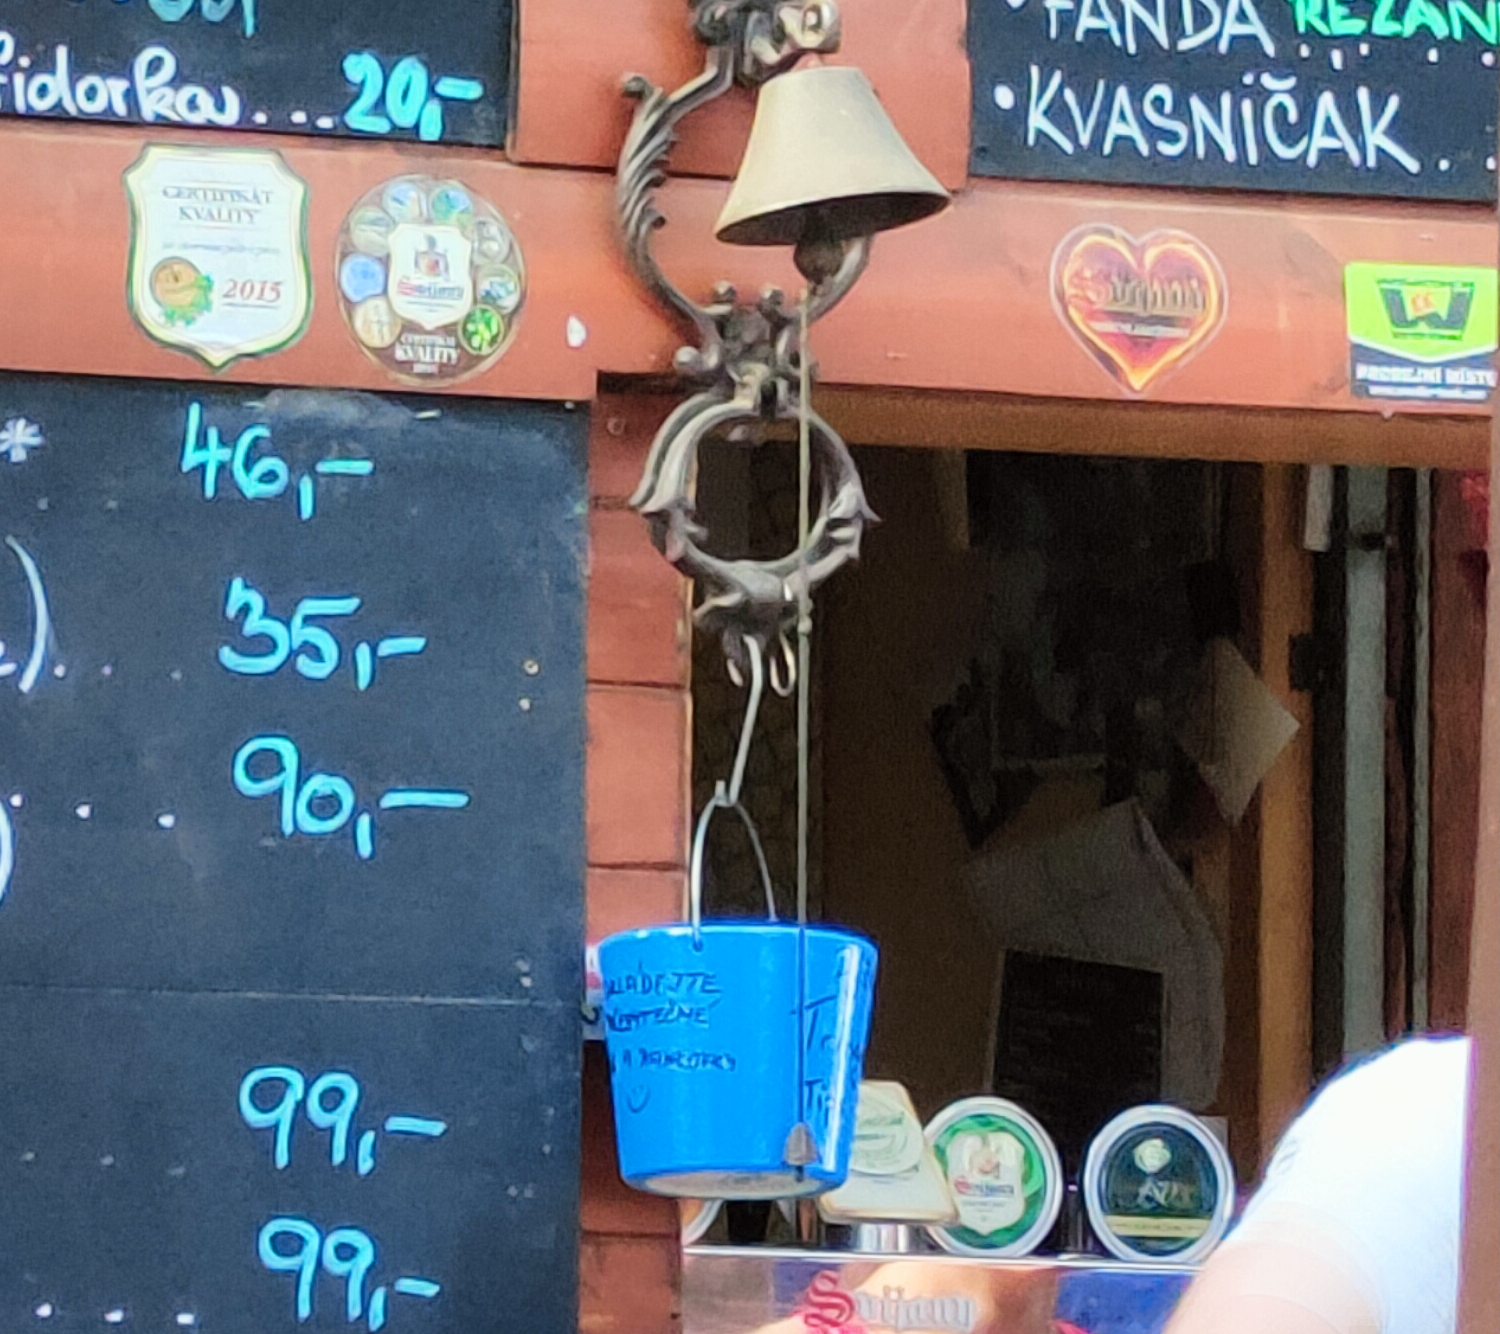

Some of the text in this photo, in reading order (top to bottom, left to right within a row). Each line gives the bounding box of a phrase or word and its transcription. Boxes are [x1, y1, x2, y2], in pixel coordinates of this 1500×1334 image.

[342, 50, 483, 141] 20,-
[179, 206, 261, 224] KVALITY
[222, 278, 283, 303] 2015
[181, 399, 374, 521] 46,-
[218, 575, 427, 691] 35,-
[233, 736, 469, 860] 90,-
[239, 1066, 447, 1176] 99,-
[258, 1217, 441, 1332] 99,-
